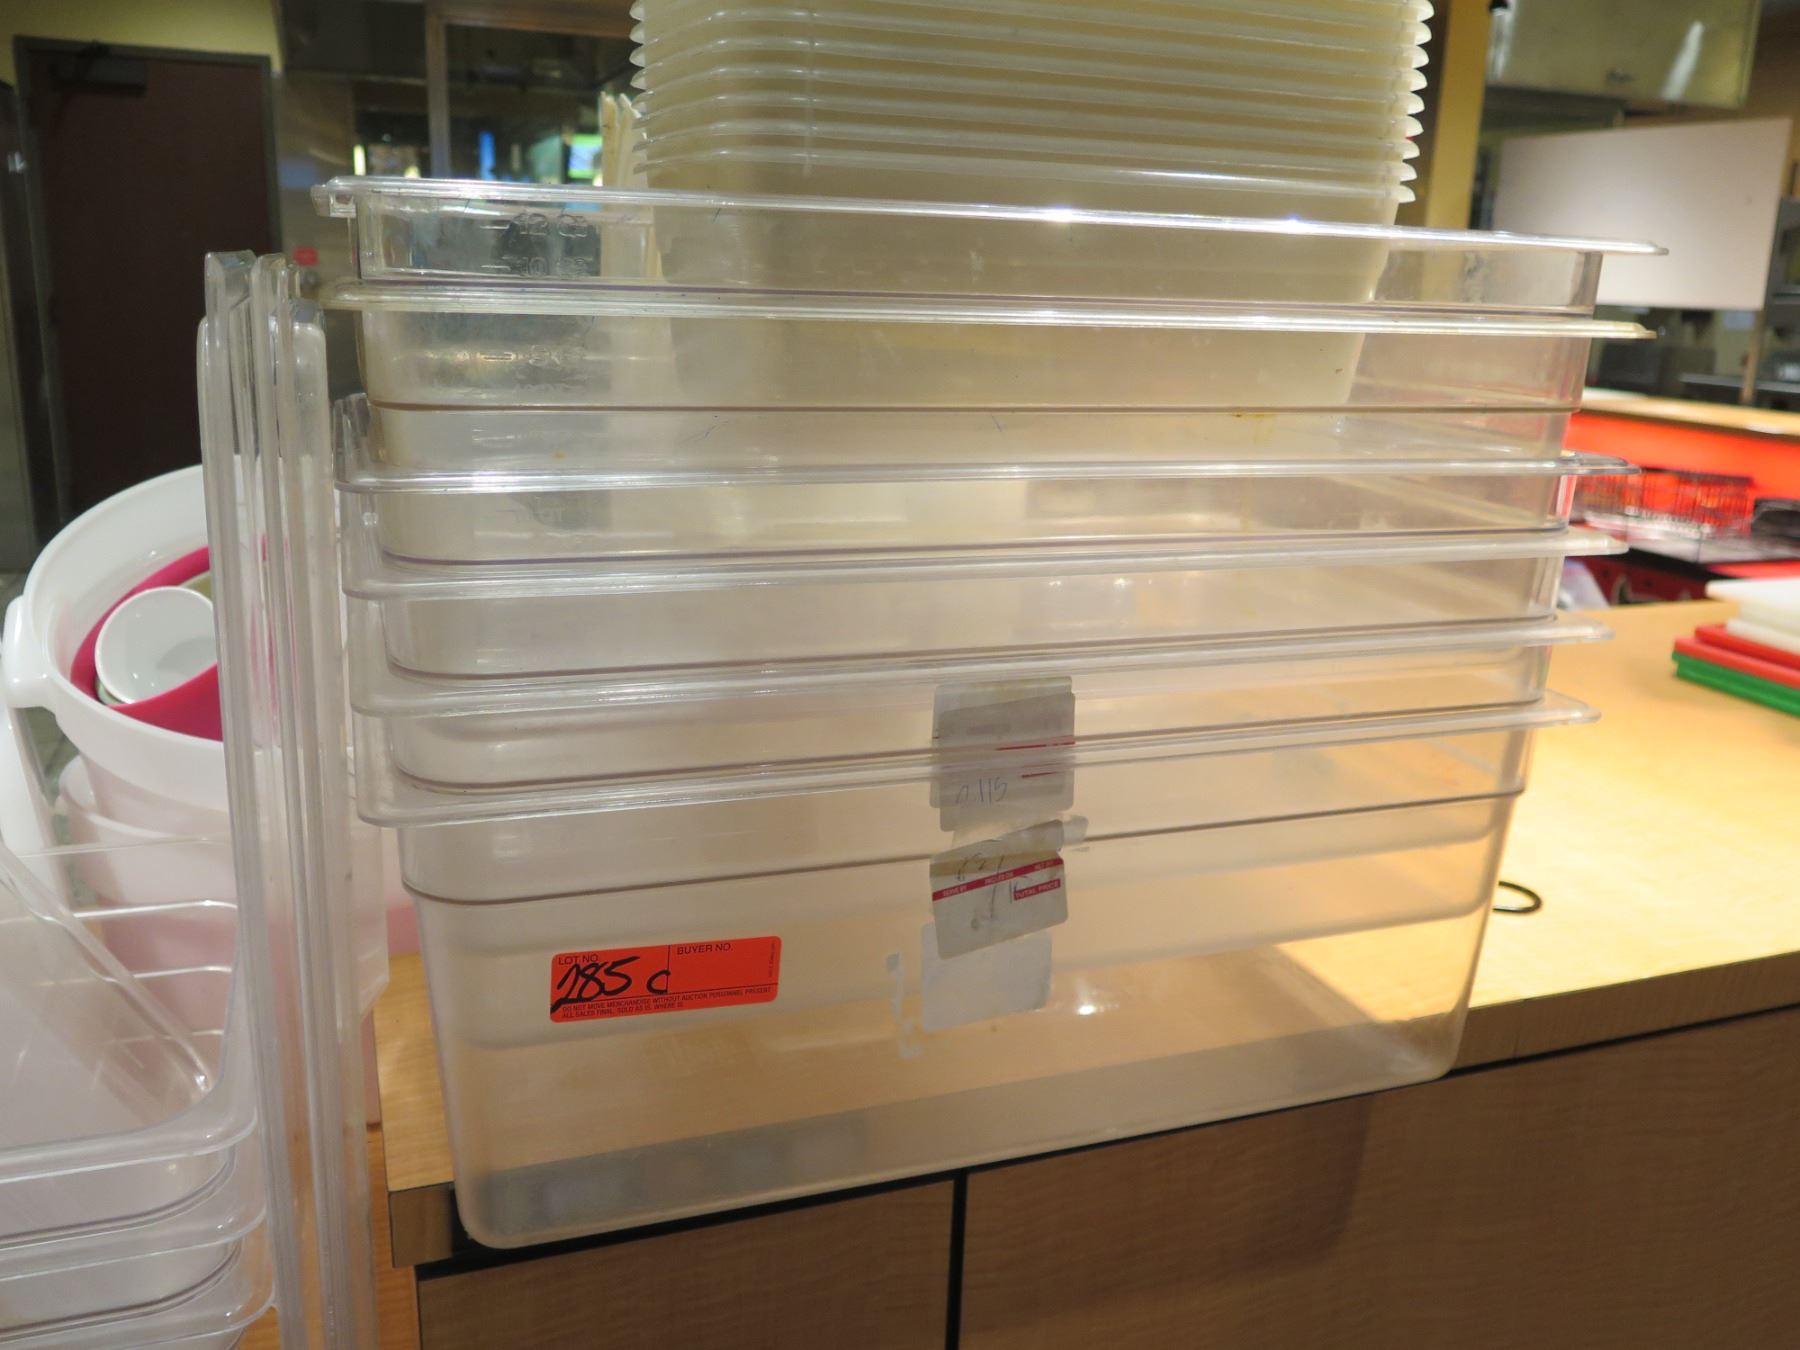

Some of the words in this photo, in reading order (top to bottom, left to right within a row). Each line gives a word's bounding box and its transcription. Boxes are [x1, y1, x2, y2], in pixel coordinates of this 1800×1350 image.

[677, 944, 713, 955] BUYER
[715, 943, 733, 951] NO.
[558, 956, 579, 965] LOT
[653, 996, 680, 1004] WITHOUT
[682, 993, 708, 1001] AUCTION
